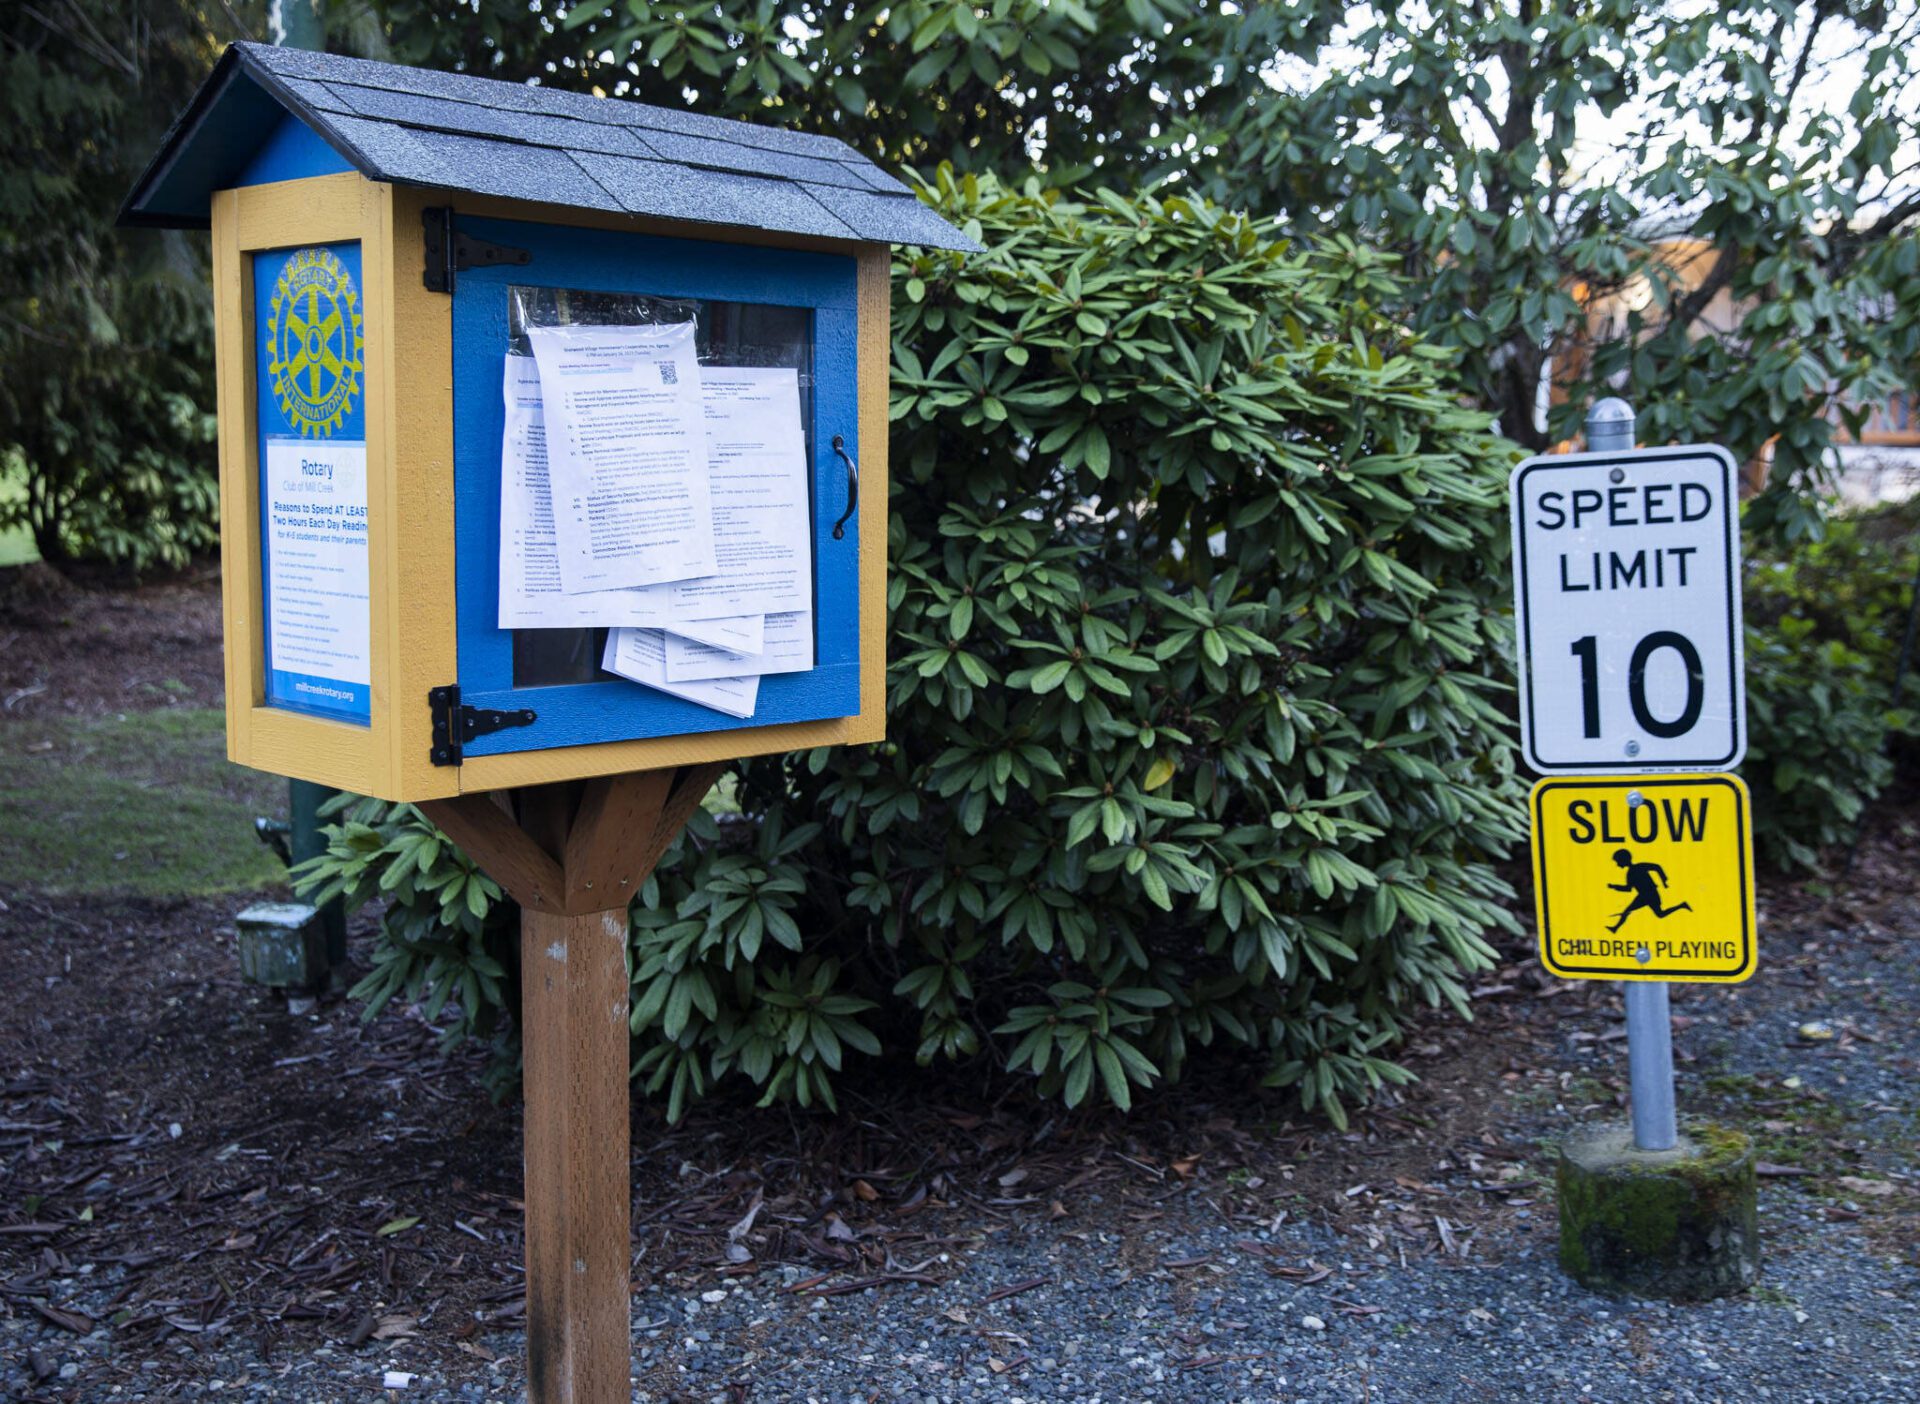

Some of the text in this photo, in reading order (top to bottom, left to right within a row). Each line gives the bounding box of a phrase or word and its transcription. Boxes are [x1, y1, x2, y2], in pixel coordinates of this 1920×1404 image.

[282, 374, 351, 420] INTERNATIONAL
[302, 459, 334, 480] Rotary
[282, 480, 334, 494] Club of Mill Creek
[274, 501, 368, 517] Reasons to Spend AT LEAST
[1536, 482, 1713, 531] SPEED
[273, 514, 286, 526] Two
[288, 516, 308, 527] Hours
[309, 518, 326, 528] Each
[327, 518, 340, 531] Day
[296, 532, 319, 542] students
[320, 534, 330, 542] and
[332, 534, 344, 544] their
[345, 536, 367, 546] parents
[1560, 547, 1698, 592] LIMIT
[296, 682, 354, 702] millcreekrotary.org
[1570, 630, 1705, 740] 10
[1568, 797, 1710, 844] SLOW
[1656, 940, 1736, 959] PLAYING
